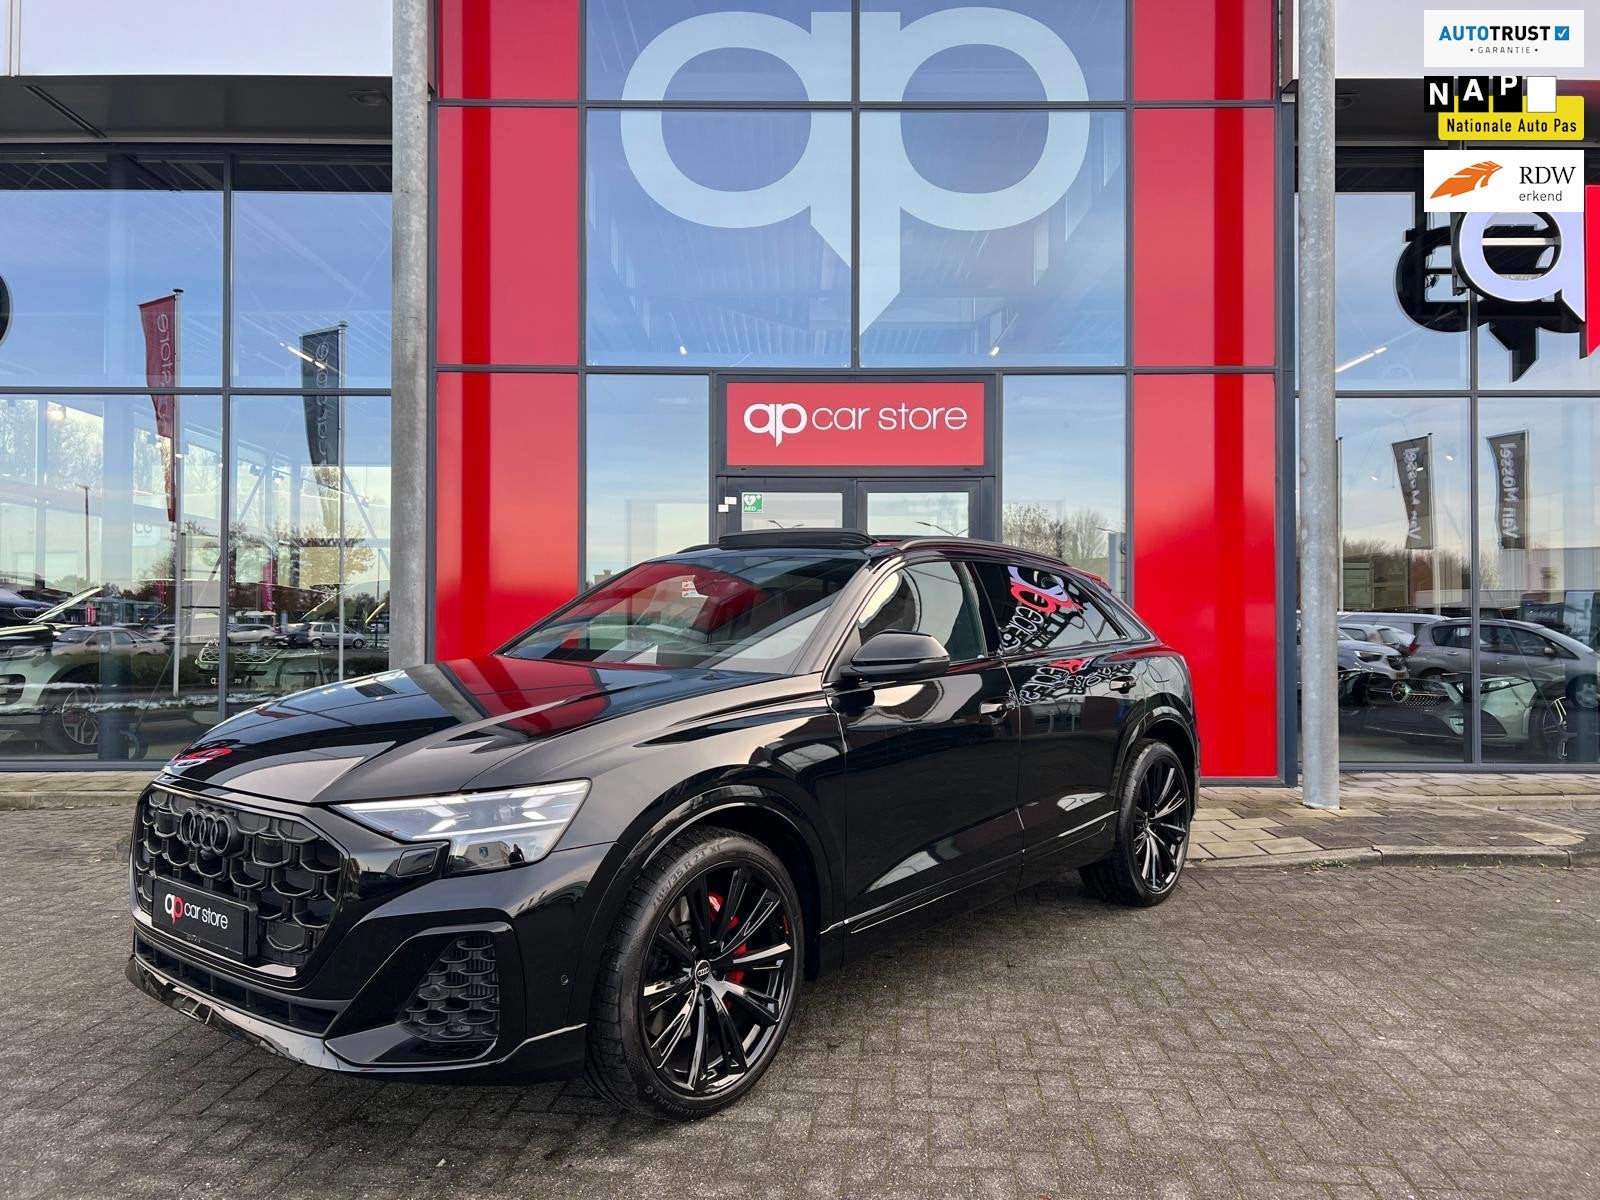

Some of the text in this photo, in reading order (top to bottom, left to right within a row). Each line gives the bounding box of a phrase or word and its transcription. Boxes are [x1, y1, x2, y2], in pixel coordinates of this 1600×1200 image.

[620, 6, 1090, 337] ap
[743, 402, 968, 448] ap car store
[164, 893, 229, 930] ap car store
